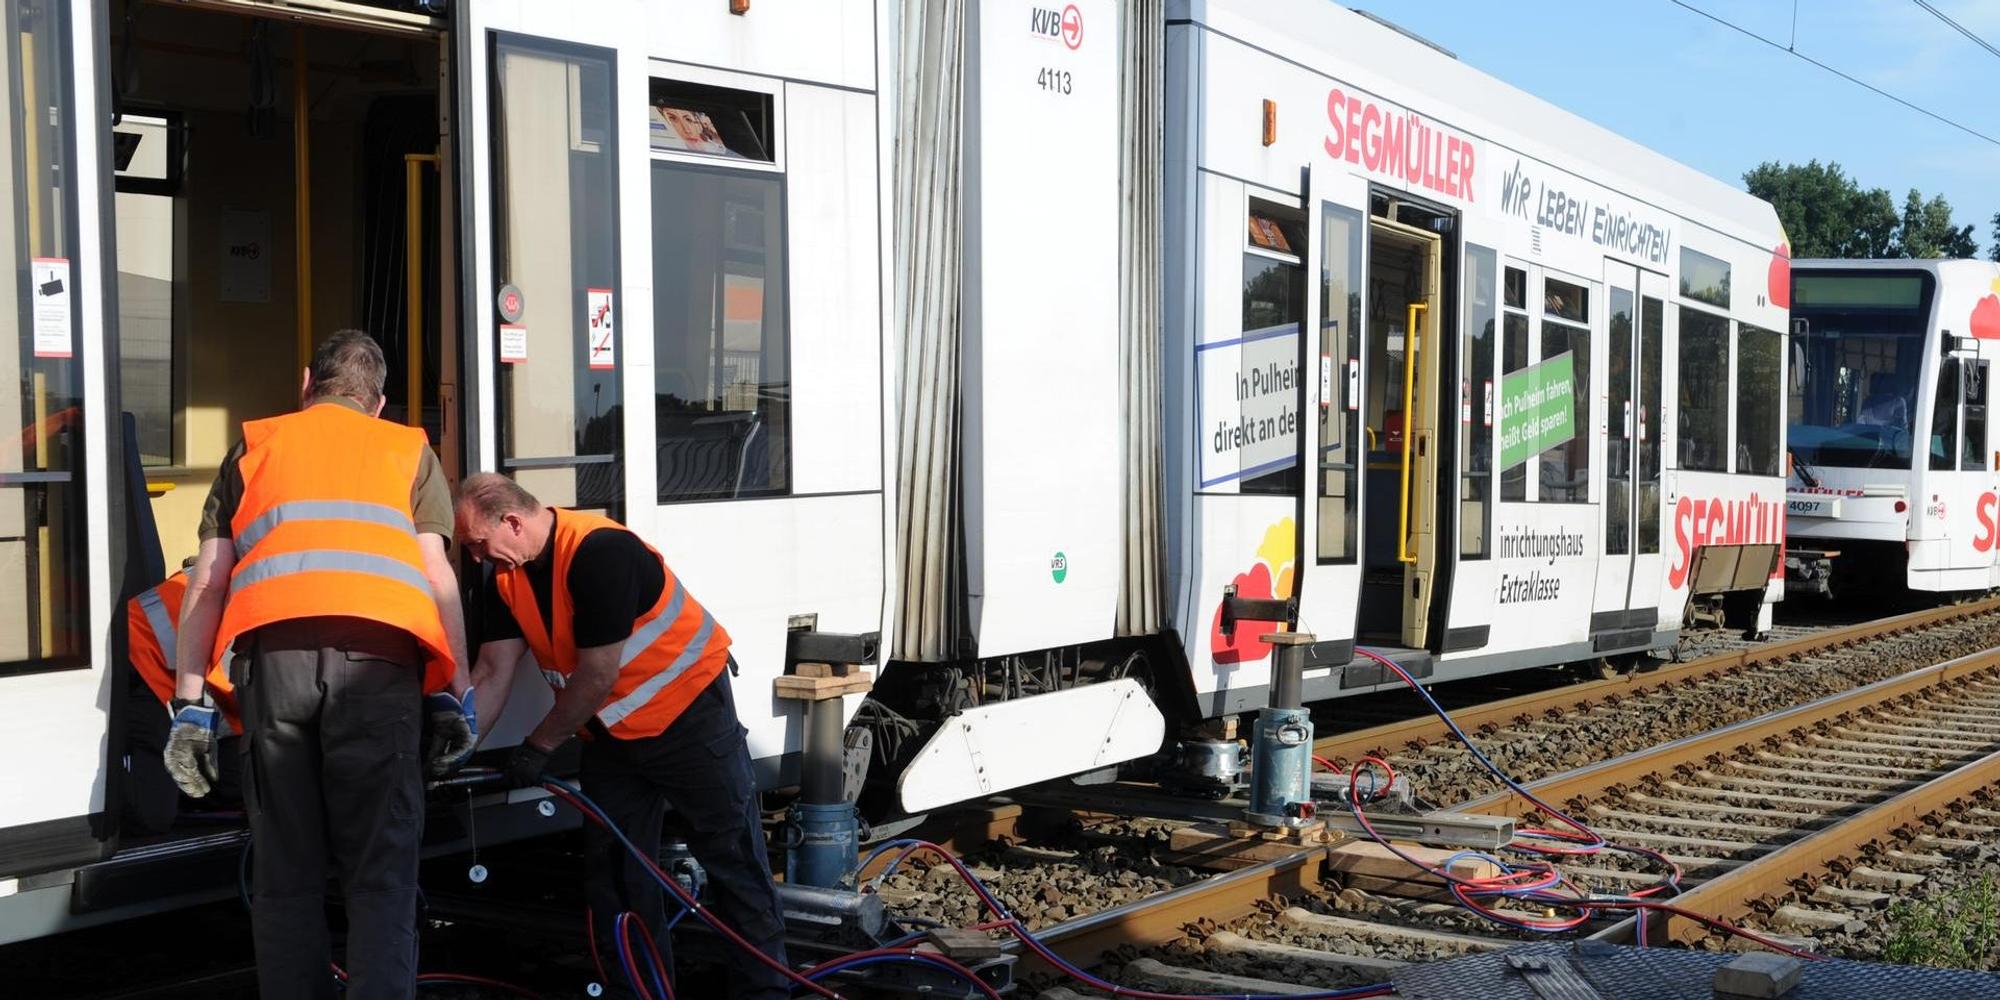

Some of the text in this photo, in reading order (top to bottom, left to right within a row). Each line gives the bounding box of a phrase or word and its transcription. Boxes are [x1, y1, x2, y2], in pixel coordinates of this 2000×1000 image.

[1031, 7, 1061, 37] KVB
[1037, 66, 1072, 95] 4113
[1324, 88, 1474, 202] SEGMÜLLER
[1537, 181, 1588, 239] LEBEN
[1236, 371, 1248, 401] In
[1514, 386, 1545, 415] Pulheim
[1214, 415, 1256, 454] direkt
[1259, 417, 1275, 441] an
[1521, 416, 1540, 441] Geld
[1540, 404, 1568, 438] sparen!
[1789, 501, 1821, 514] 4097
[1973, 492, 2000, 552] S
[1050, 558, 1064, 569] VRS
[1499, 570, 1561, 604] Extraklasse
